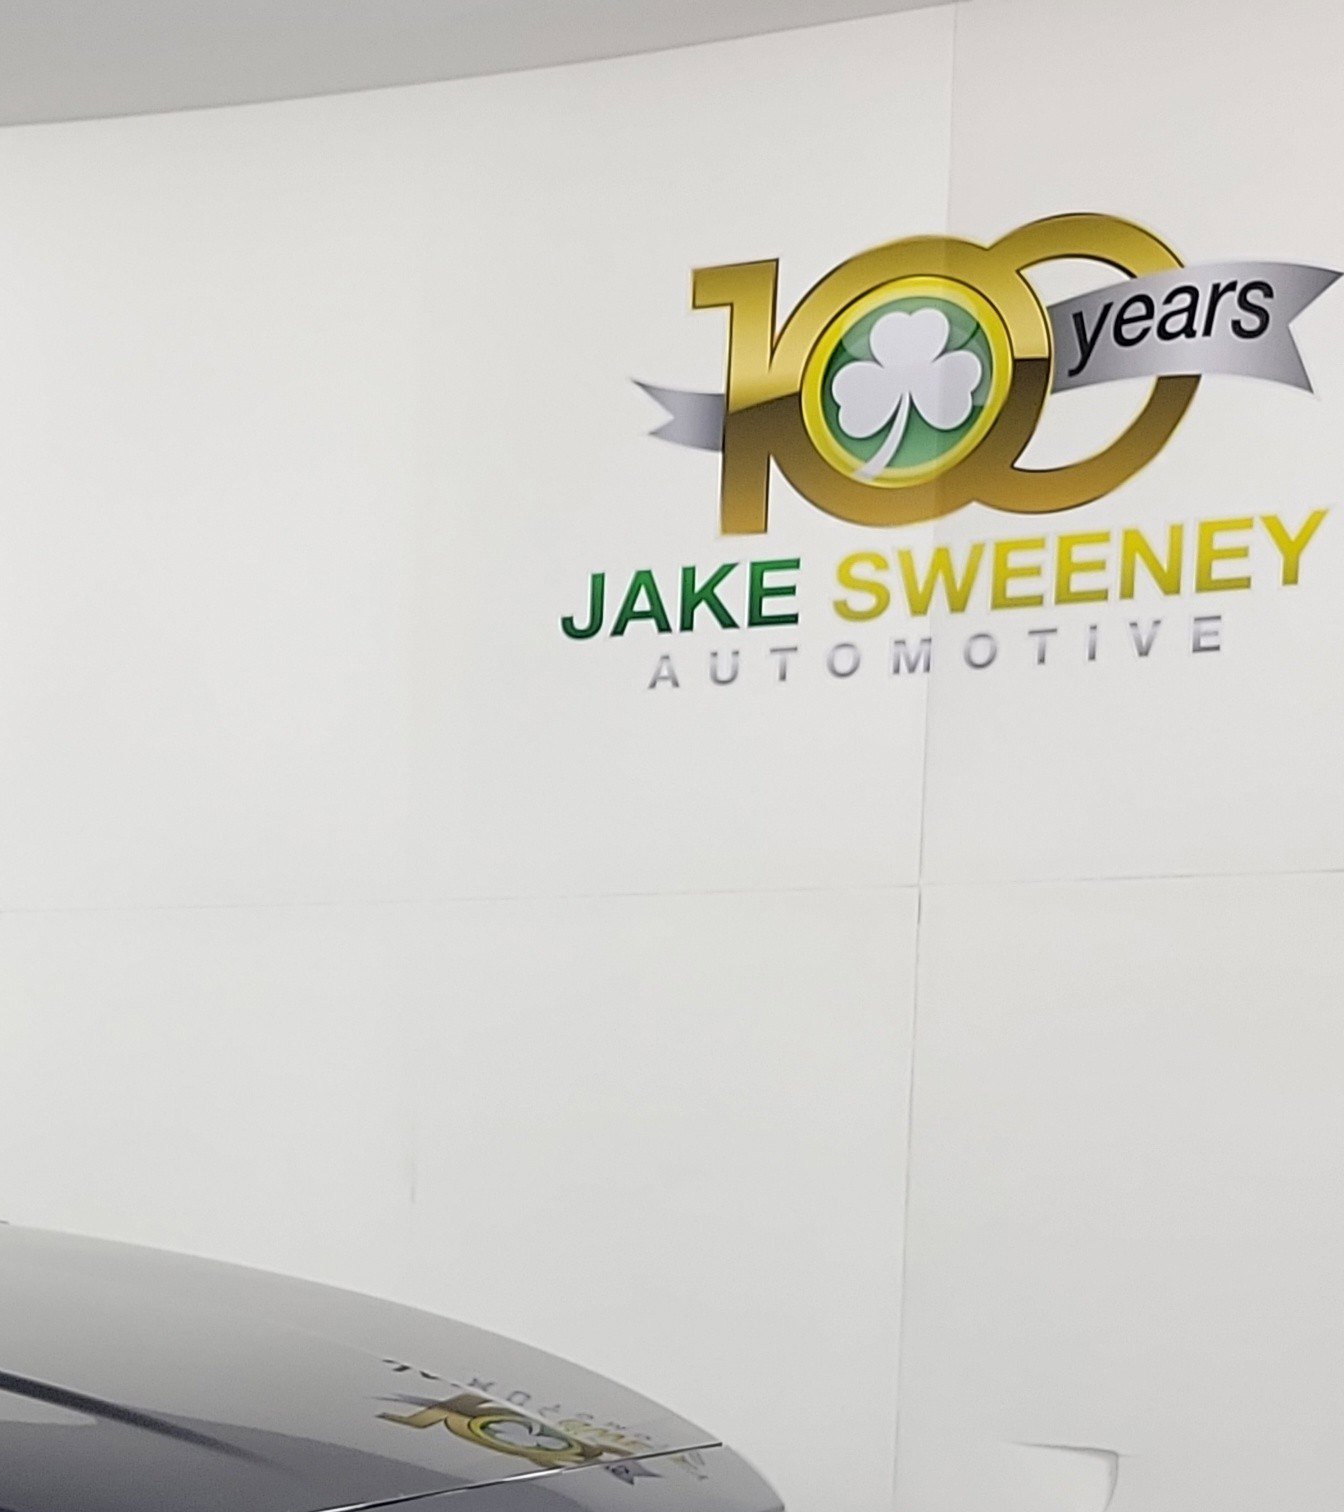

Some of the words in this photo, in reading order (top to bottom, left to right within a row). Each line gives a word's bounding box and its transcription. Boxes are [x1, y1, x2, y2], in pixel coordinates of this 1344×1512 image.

[690, 211, 1202, 537] 100
[1067, 270, 1274, 378] years
[560, 557, 802, 641] JAKE
[832, 508, 1330, 624] SWEENEY
[646, 615, 1224, 692] AUTOMOTIVE
